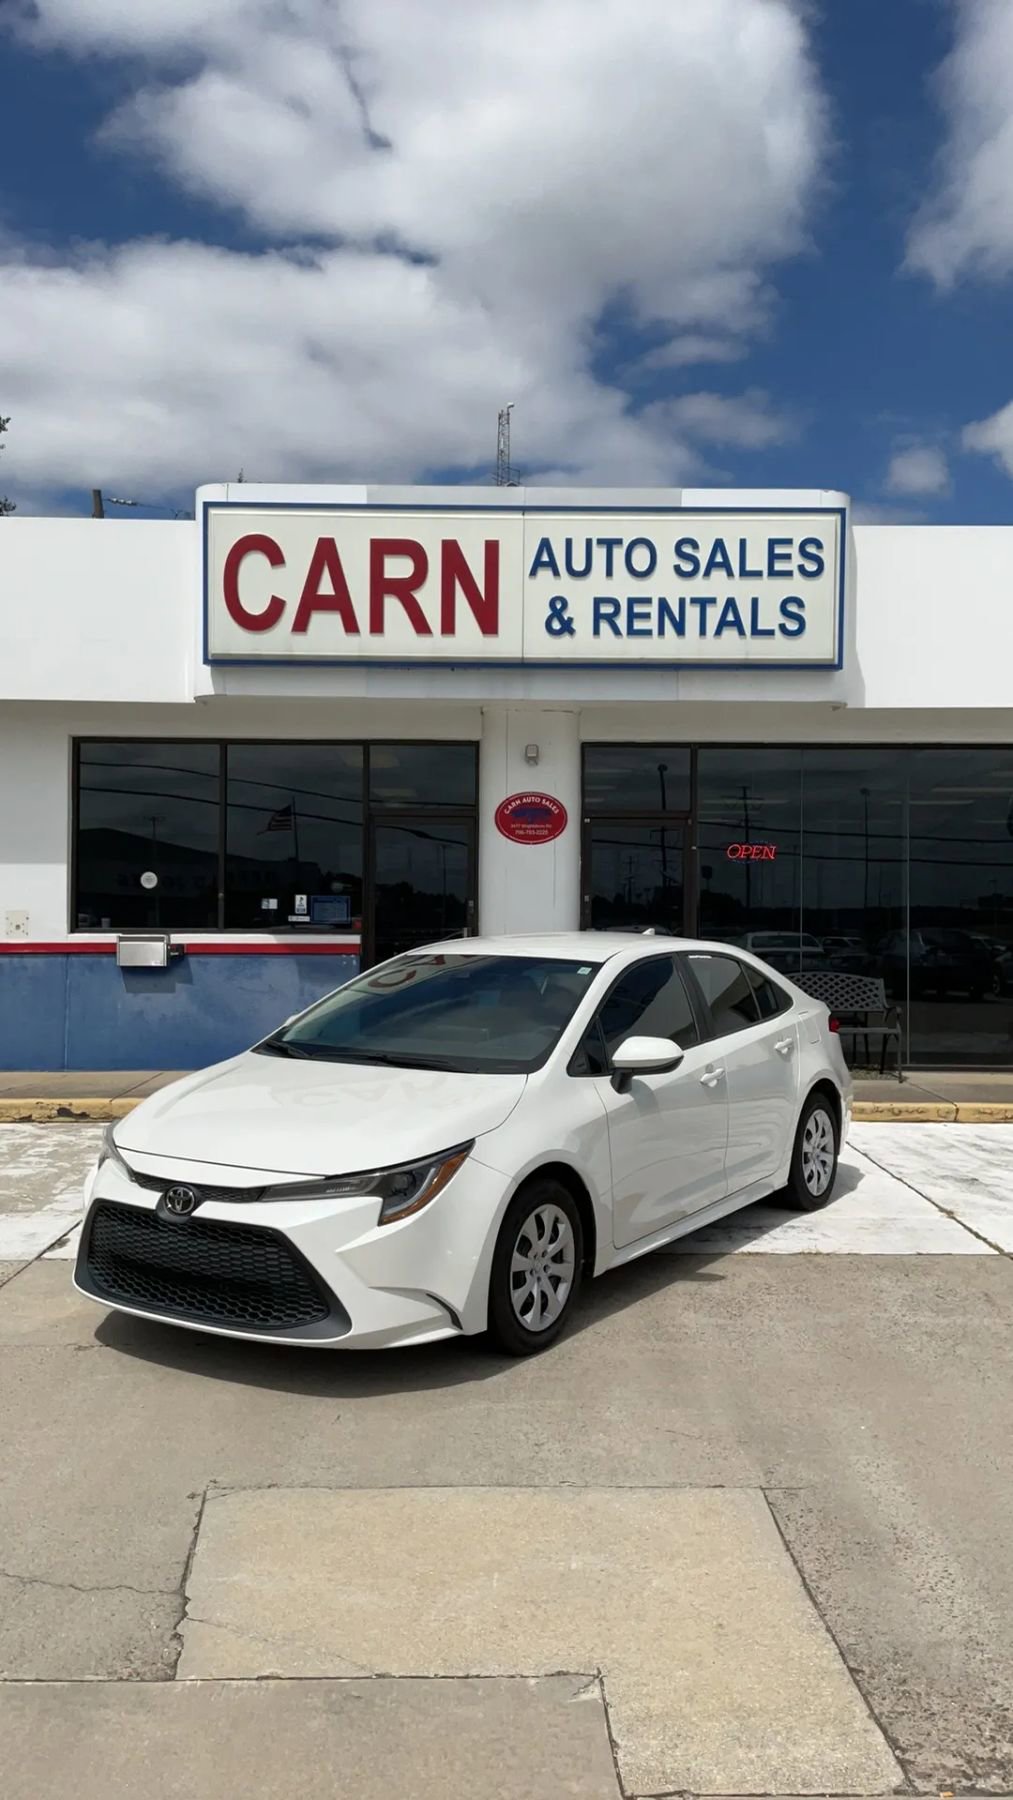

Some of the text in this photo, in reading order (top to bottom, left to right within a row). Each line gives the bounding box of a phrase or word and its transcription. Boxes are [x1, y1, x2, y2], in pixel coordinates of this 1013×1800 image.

[530, 537, 826, 579] AUTO SALES
[223, 534, 500, 636] CARN
[545, 596, 807, 638] & RENTALS
[541, 798, 560, 814] SALES
[727, 843, 777, 860] OPEN
